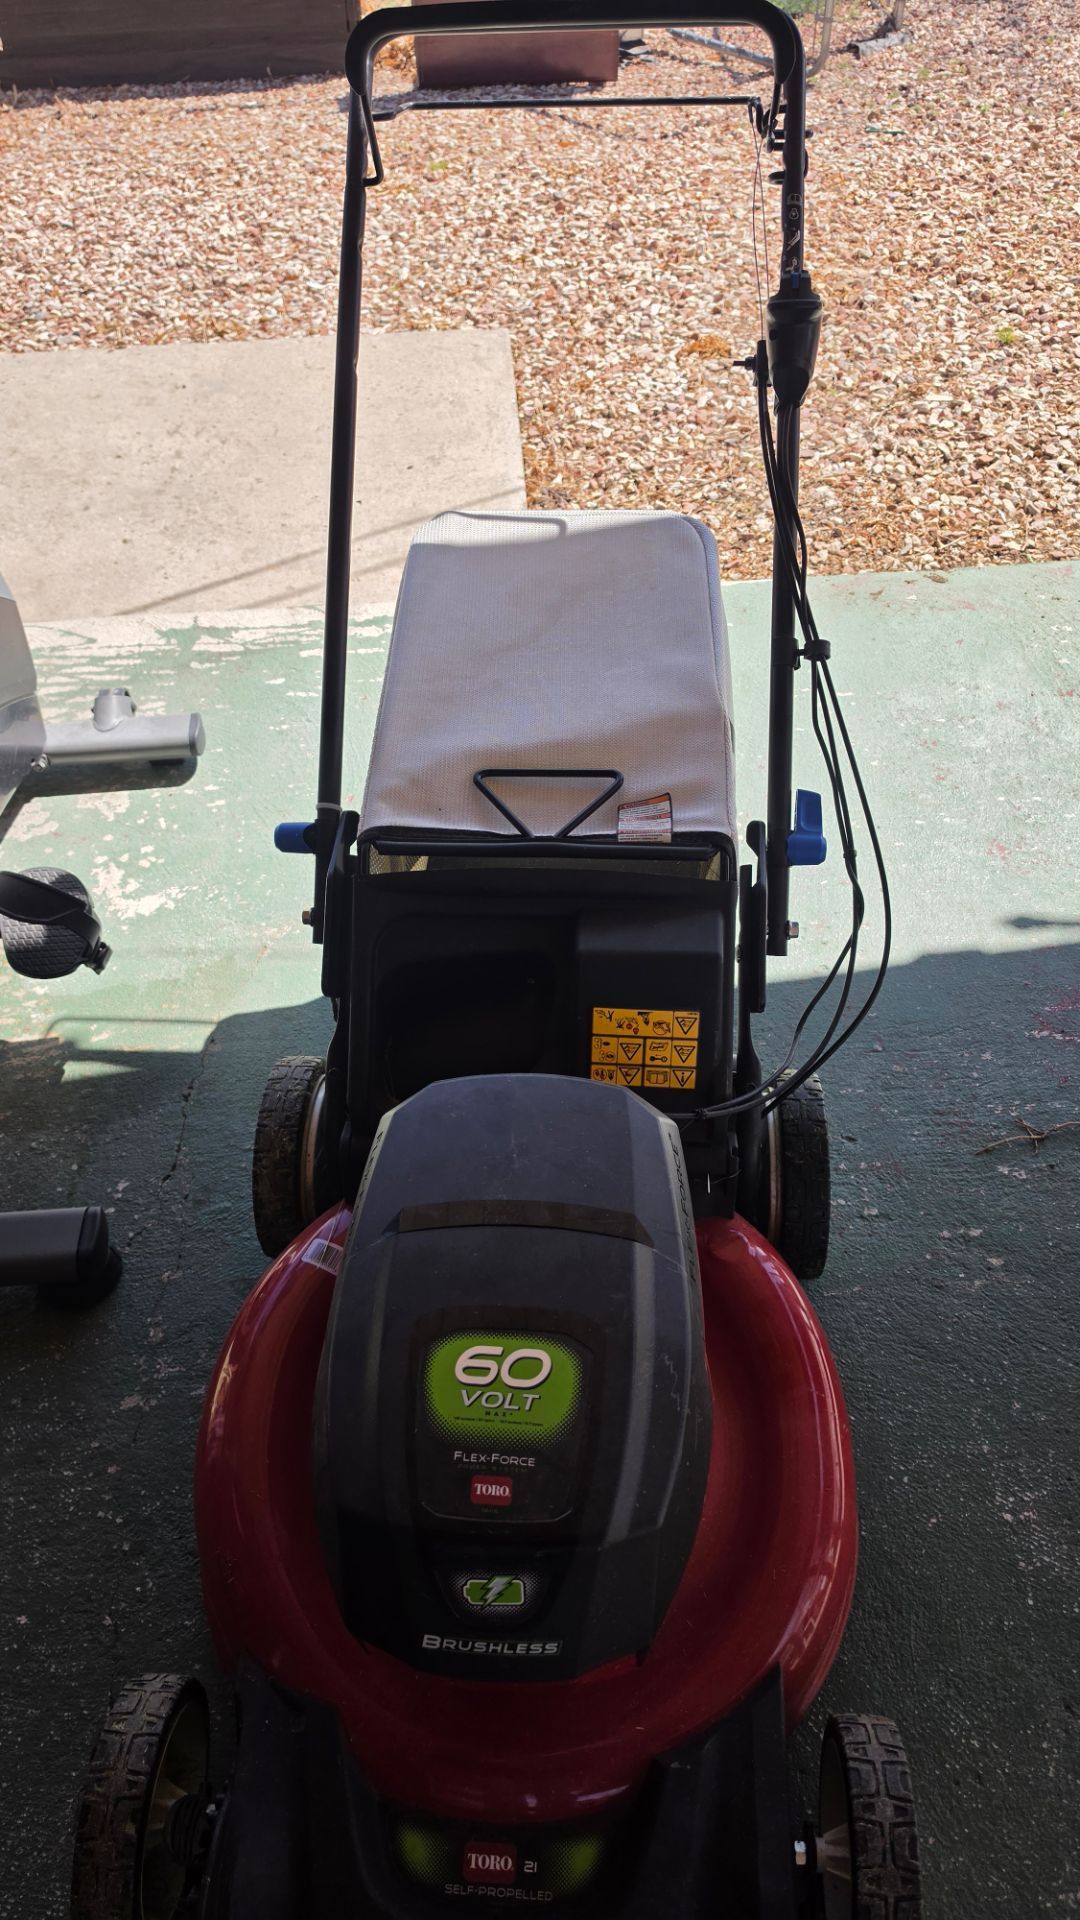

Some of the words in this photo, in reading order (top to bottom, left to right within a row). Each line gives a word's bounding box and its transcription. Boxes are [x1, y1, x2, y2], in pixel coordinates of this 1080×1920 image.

[454, 1345, 552, 1389] 60
[460, 1389, 541, 1411] VOLT
[453, 1450, 536, 1467] FLEX-FORCE
[474, 1483, 511, 1497] TORO
[421, 1634, 559, 1655] BRUSHLESS
[467, 1853, 513, 1871] TORO
[523, 1860, 538, 1873] 21
[444, 1883, 553, 1902] SELF-PROPELLED
